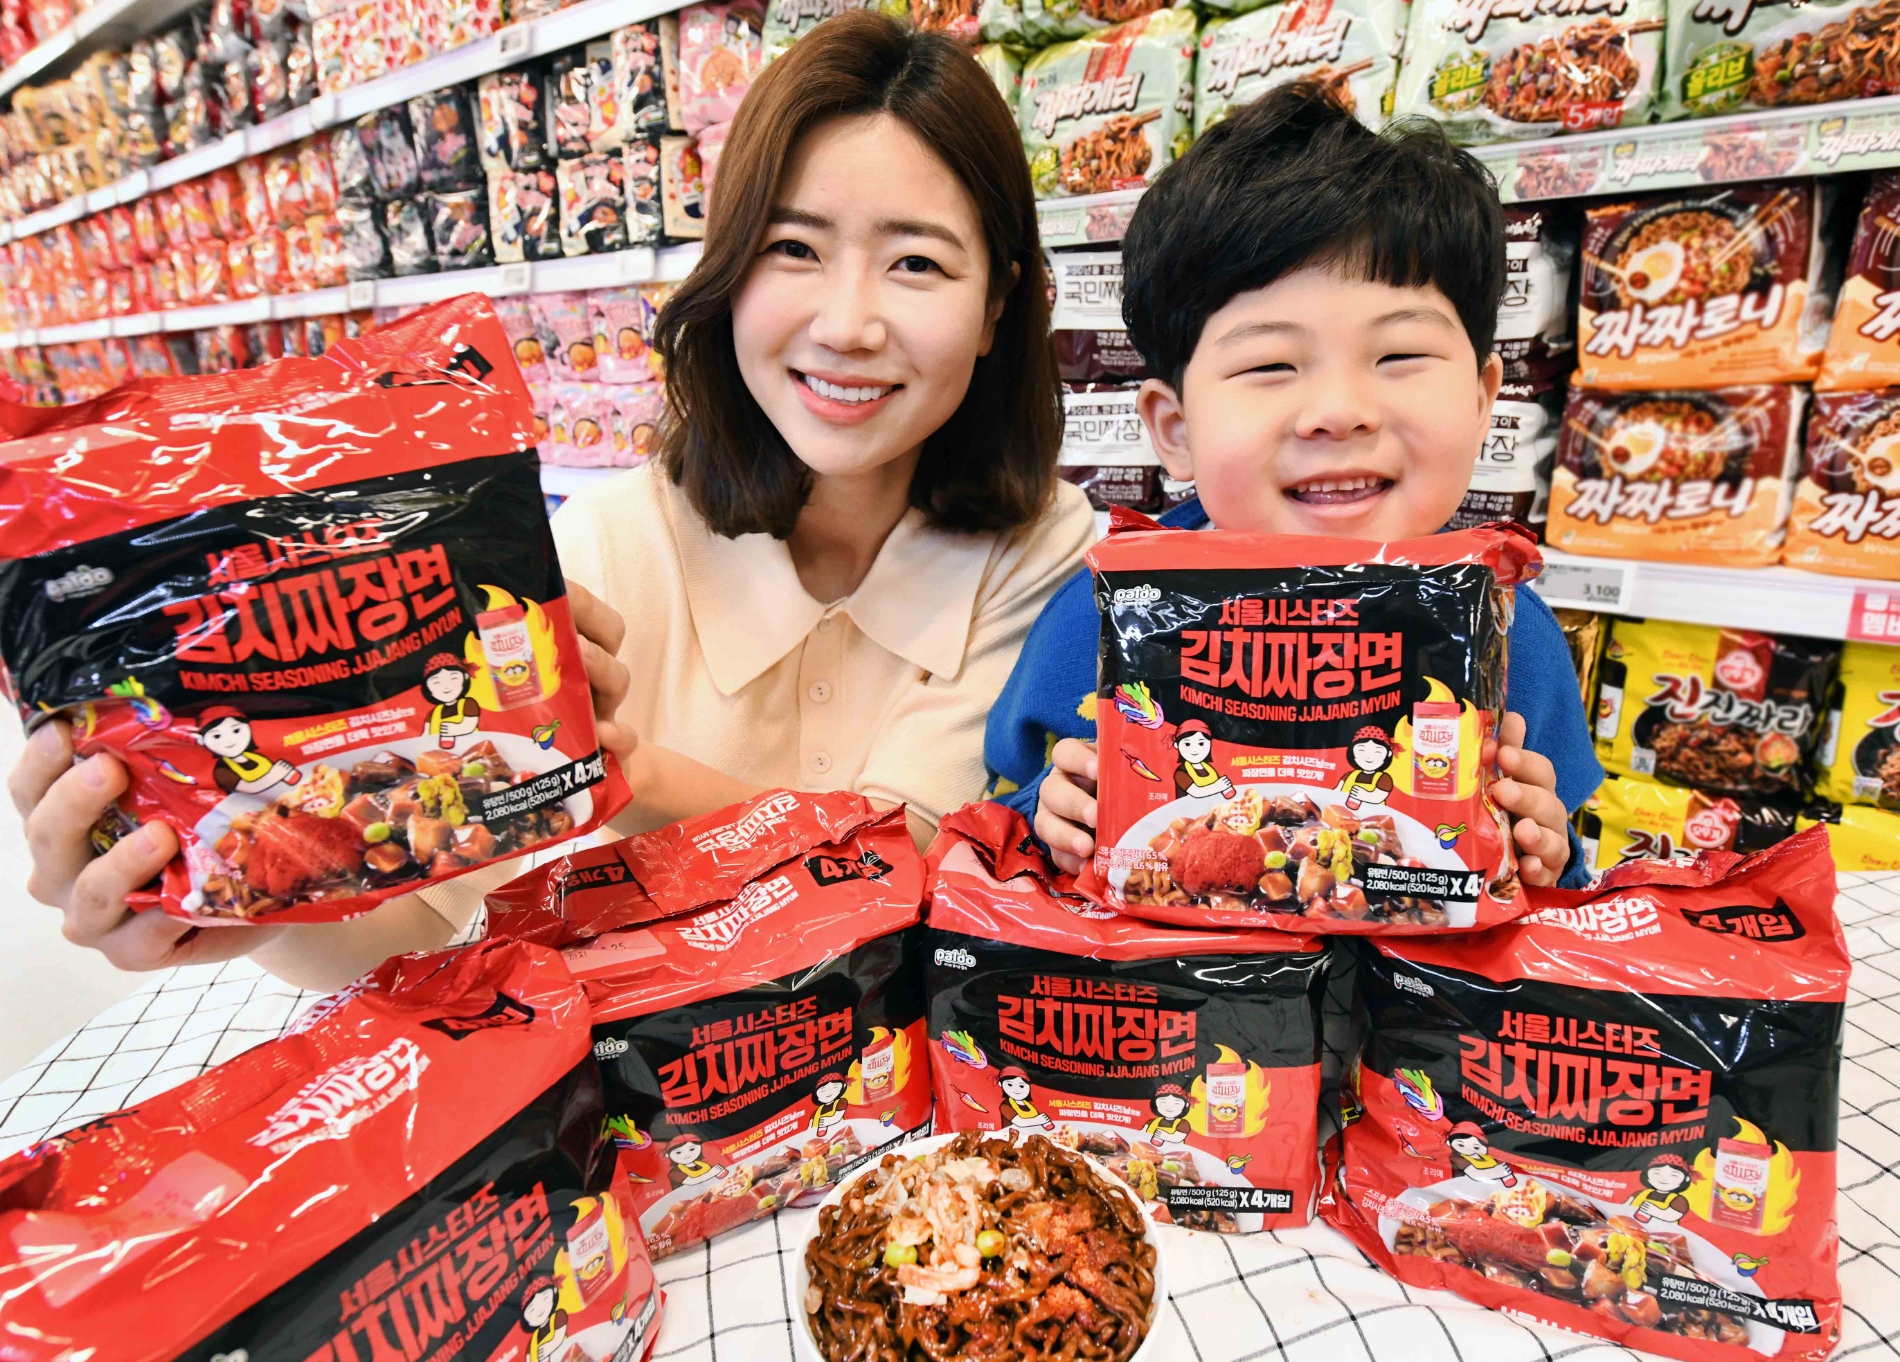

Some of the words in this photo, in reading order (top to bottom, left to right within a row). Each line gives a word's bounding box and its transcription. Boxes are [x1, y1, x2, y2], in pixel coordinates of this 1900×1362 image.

[1207, 18, 1351, 99] 짜파게티
[1433, 62, 1484, 98] 올리브
[1687, 56, 1746, 99] 올리브
[1031, 72, 1144, 138] 짜파게티
[1065, 281, 1124, 304] 국민짜
[1585, 283, 1784, 358] 짜짜로니
[1565, 476, 1753, 525] 짜짜로니
[162, 543, 457, 664] 김치짜장면
[1114, 584, 1161, 605] paldo
[1218, 598, 1359, 626] 서울시스터즈
[179, 669, 250, 693] KIMCHI
[250, 659, 351, 693] SEASONING
[352, 632, 423, 676] JJAJANG
[422, 606, 464, 648] MYUN
[1180, 627, 1402, 700] 김치짜장면
[1180, 684, 1222, 711] KIMCHI
[1224, 699, 1296, 722] SEASONING
[1299, 701, 1359, 723] JJAJANG
[1361, 689, 1401, 715] MYUN
[1646, 674, 1814, 737] 진진짜라
[677, 875, 794, 944] 김치짜장면
[1635, 922, 1662, 937] MYUN
[934, 948, 976, 967] paldo
[1030, 975, 1158, 1003] 서울시스터즈
[593, 1036, 629, 1056] ldo
[689, 995, 817, 1049] 서울시스터즈
[997, 994, 1197, 1061] 김치짜장면
[1498, 1010, 1661, 1059] 서울시스터즈
[657, 1006, 852, 1109] 김치짜장면
[665, 1108, 709, 1126] KIMCHI
[709, 1085, 770, 1121] SEASONING
[770, 1061, 820, 1094] JJAJANG
[820, 1045, 852, 1069] MYUN
[999, 1038, 1039, 1065] KIMCHI
[1040, 1054, 1105, 1077] SEASONING
[1106, 1063, 1159, 1079] JJAJANG
[1161, 1054, 1196, 1076] MYUN
[1458, 1034, 1712, 1126] 김치짜장면
[1461, 1083, 1506, 1122] KIMCHI
[1504, 1112, 1586, 1143] SEASONING
[1587, 1129, 1658, 1148] JJAJANG
[1660, 1124, 1706, 1146] MYUN
[339, 1180, 501, 1324] 서울시스터즈
[464, 1273, 518, 1342] JJAJANG
[518, 1232, 556, 1279] MYUN
